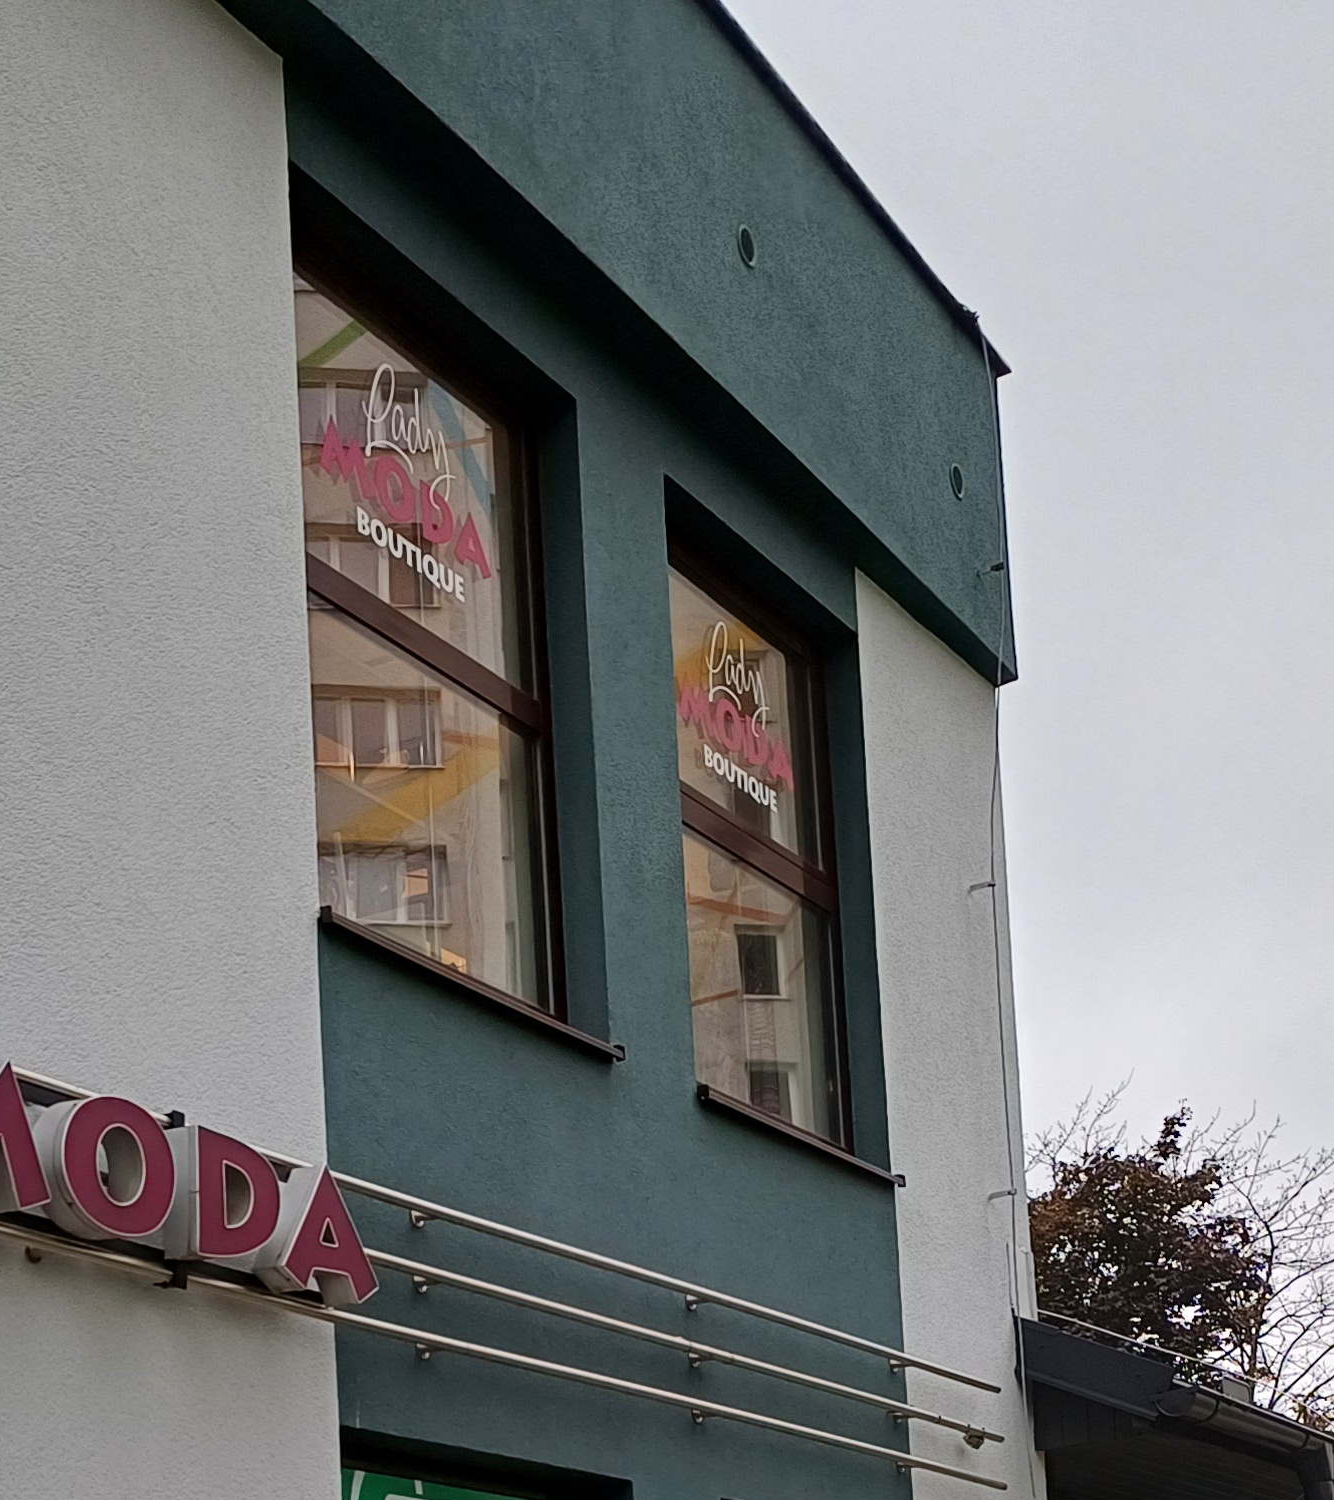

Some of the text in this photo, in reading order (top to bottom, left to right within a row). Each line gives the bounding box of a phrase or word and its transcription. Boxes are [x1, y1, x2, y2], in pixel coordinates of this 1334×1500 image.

[362, 363, 457, 511] Lady
[319, 413, 493, 580] MODA
[356, 506, 466, 603] BOUTIQUE
[705, 621, 770, 738] Lady
[677, 685, 795, 792] MODA
[703, 743, 778, 813] BOUTIQUE
